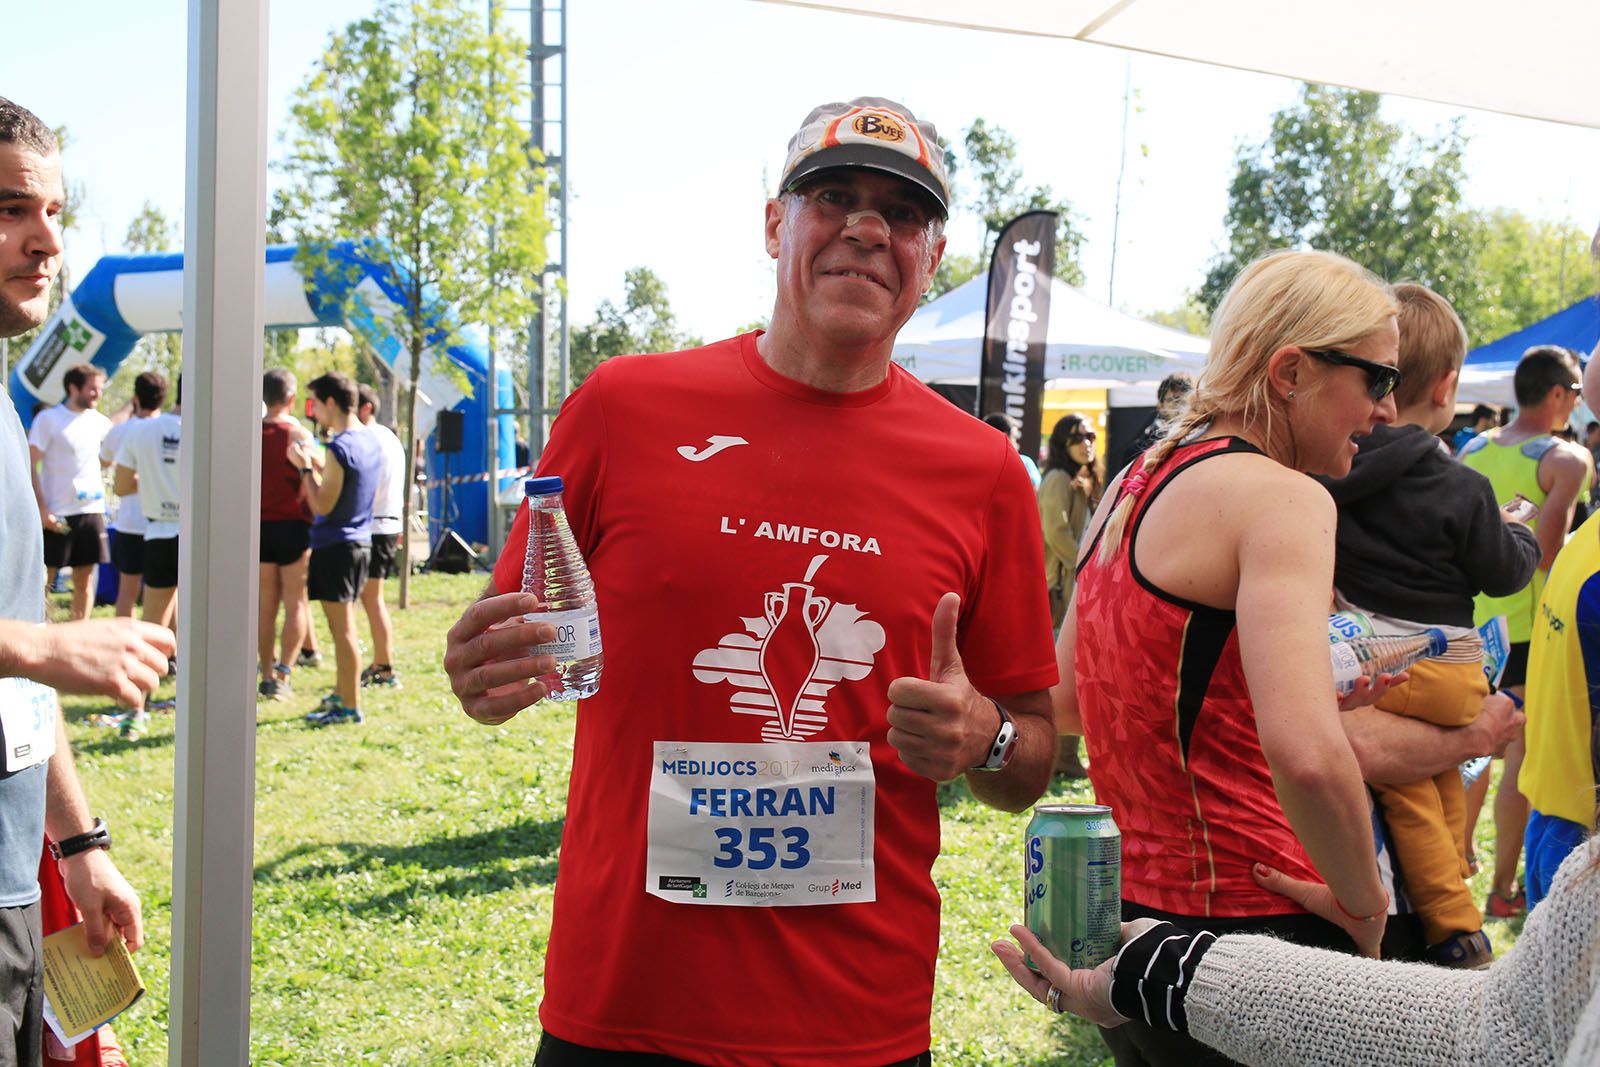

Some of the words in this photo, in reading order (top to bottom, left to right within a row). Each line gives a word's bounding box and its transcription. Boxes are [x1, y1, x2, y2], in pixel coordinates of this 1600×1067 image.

[720, 516, 746, 534] L'
[754, 521, 882, 555] AMFORA
[689, 786, 835, 817] FERRAN
[713, 826, 811, 870] 353
[735, 889, 744, 897] de
[761, 881, 770, 890] de
[808, 883, 831, 893] Grup
[841, 881, 862, 890] Med
